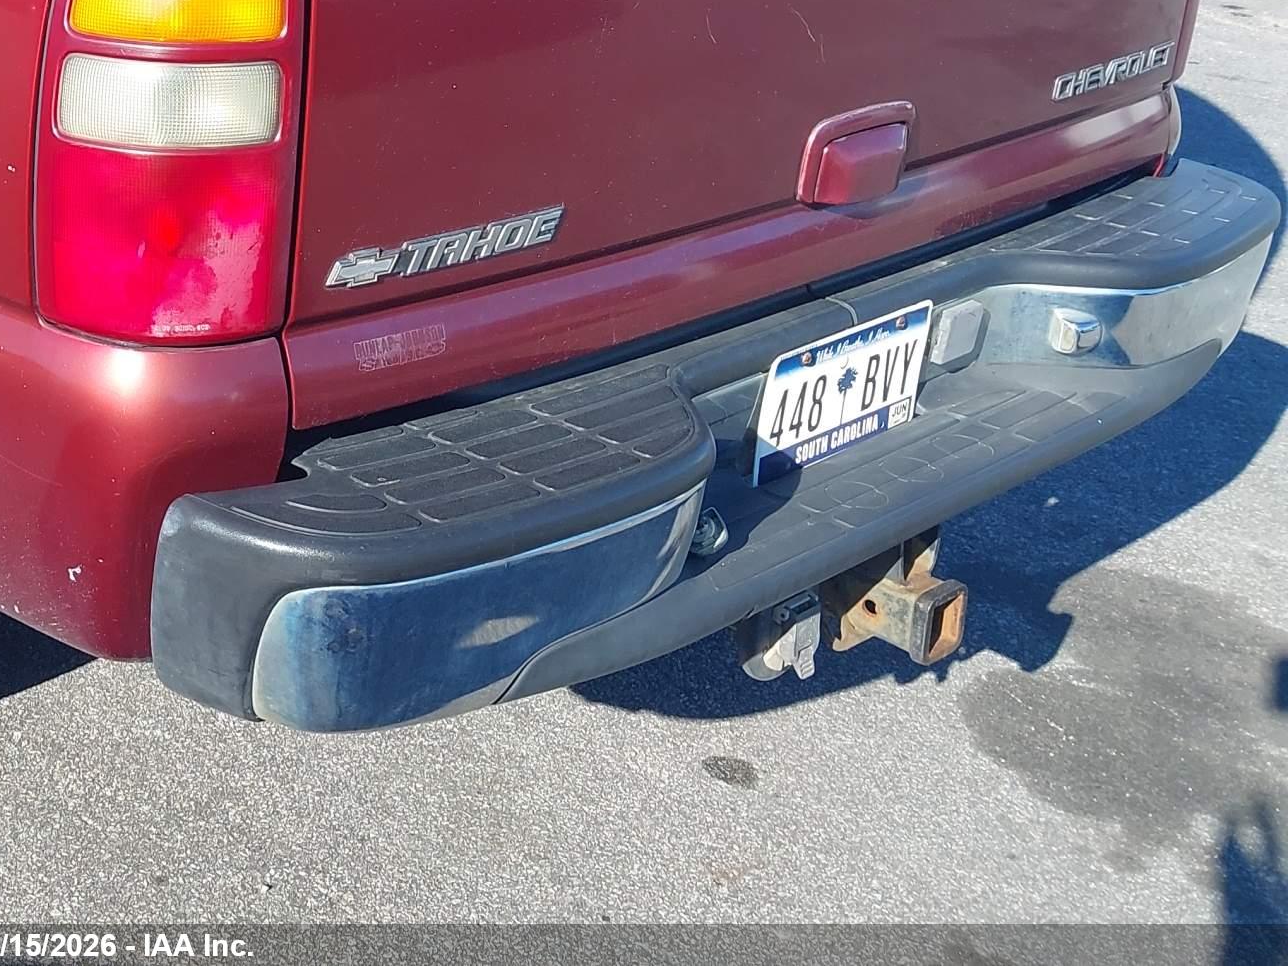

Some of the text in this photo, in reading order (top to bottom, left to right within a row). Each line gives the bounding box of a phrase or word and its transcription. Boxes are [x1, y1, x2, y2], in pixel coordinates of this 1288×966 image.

[1052, 41, 1175, 102] CHEVROLET
[403, 203, 564, 276] TAHOE
[769, 338, 919, 447] 448 BVY
[795, 414, 879, 464] SOUTH CAROLINA
